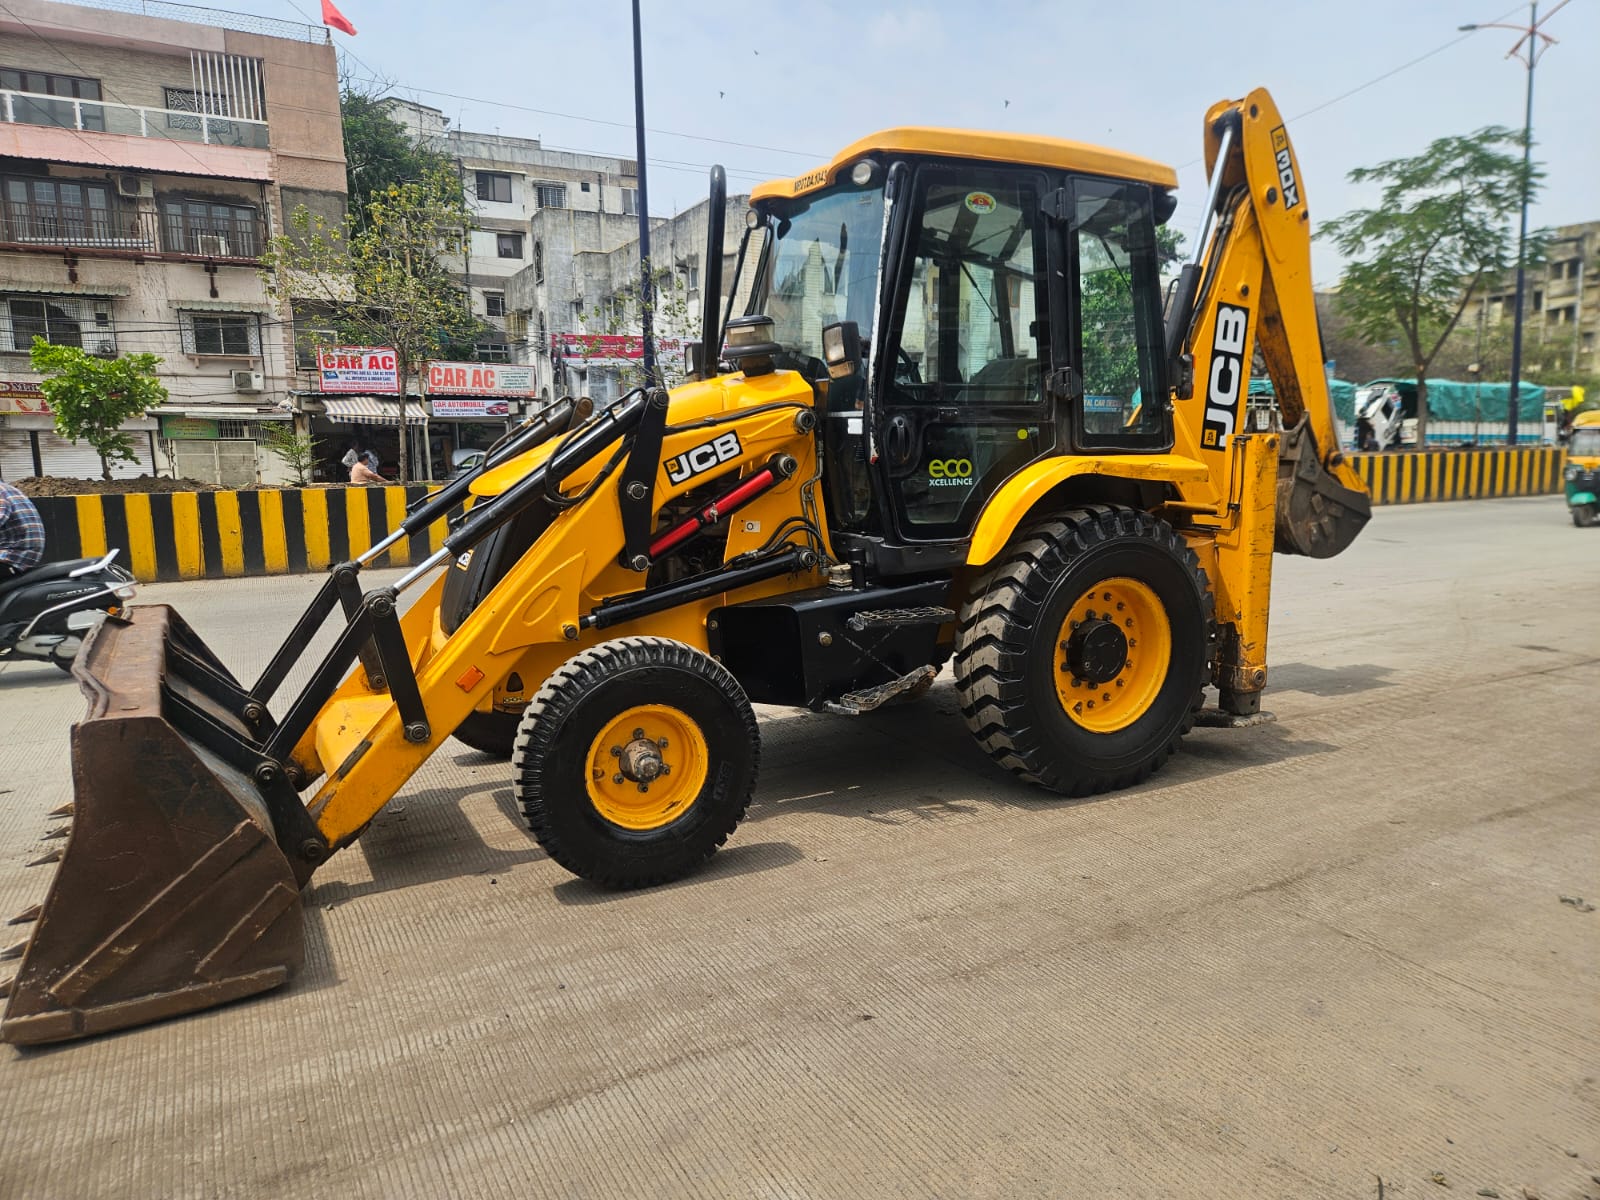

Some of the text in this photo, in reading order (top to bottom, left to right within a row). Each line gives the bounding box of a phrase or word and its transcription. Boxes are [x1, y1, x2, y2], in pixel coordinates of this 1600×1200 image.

[1276, 149, 1299, 209] 3DX
[322, 354, 394, 370] CAR AC
[430, 366, 467, 387] CAR
[472, 368, 495, 388] AC
[1206, 306, 1246, 448] JCB
[670, 432, 740, 483] JCB
[928, 458, 973, 478] eco
[928, 478, 973, 486] XCELLENCE
